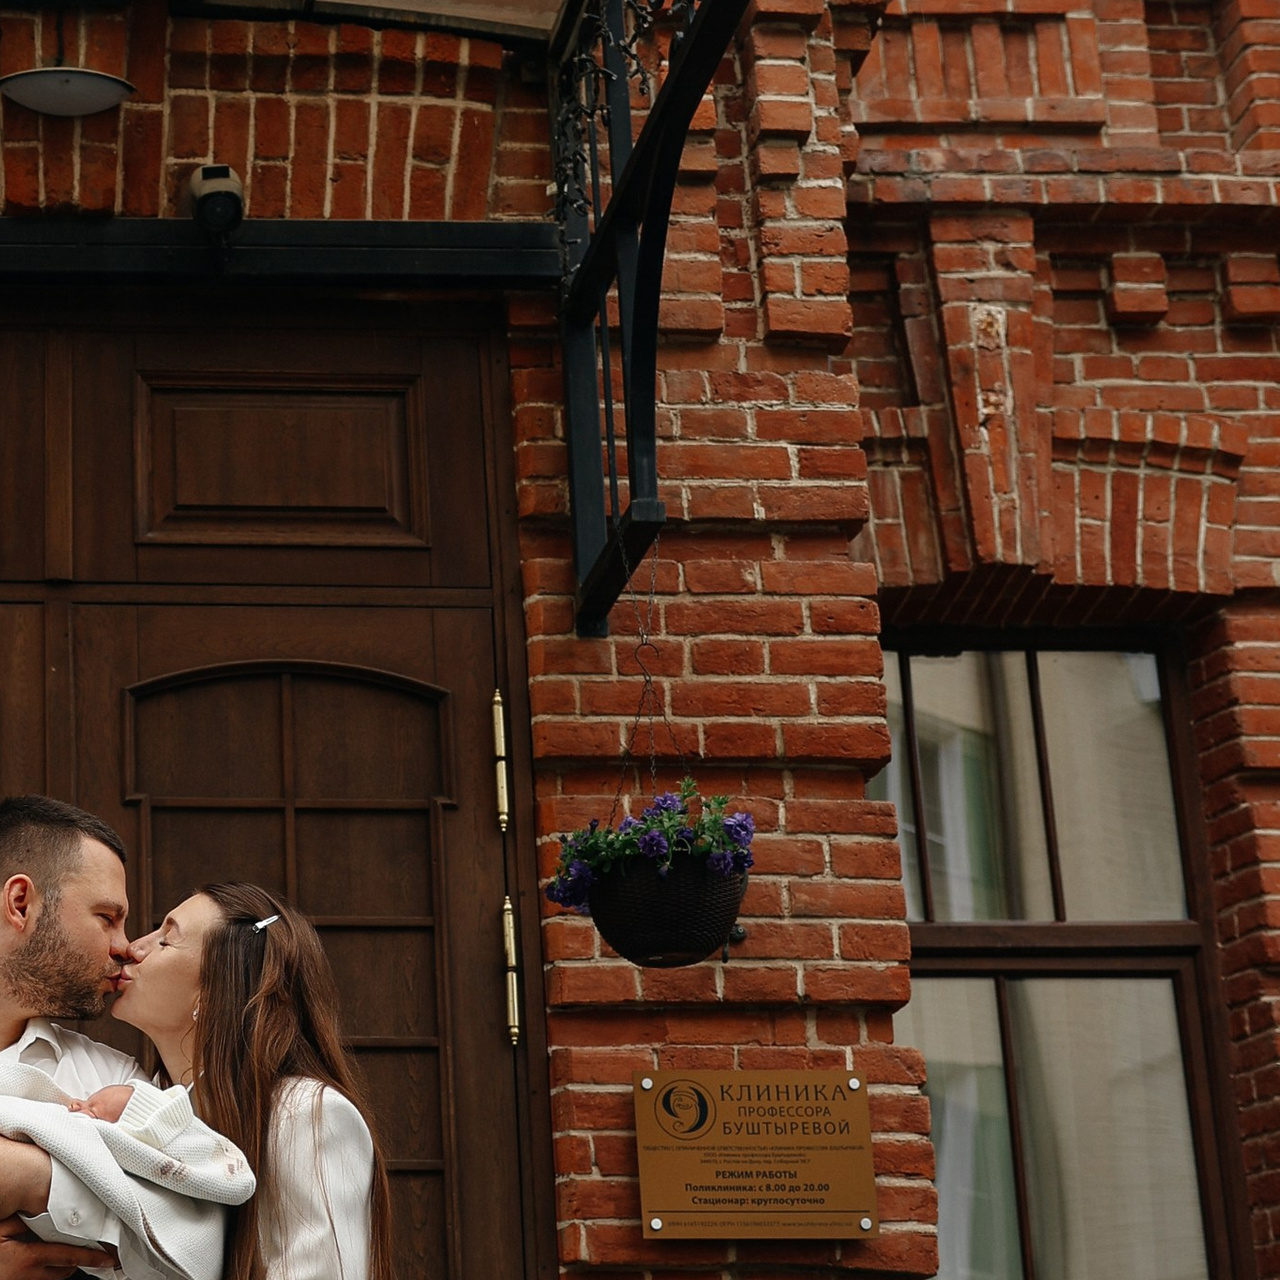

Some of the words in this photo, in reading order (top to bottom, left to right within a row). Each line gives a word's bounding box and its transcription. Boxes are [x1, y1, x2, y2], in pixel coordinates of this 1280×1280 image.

[720, 1084, 848, 1102] КЛИНИКА
[737, 1106, 832, 1118] ПРОФЕССОРА
[722, 1119, 851, 1136] БУШТЫРЕВОЙ
[715, 1170, 754, 1180] РЕЖИМ
[755, 1170, 798, 1180] РАБОТЫ
[684, 1183, 757, 1193] Поликлиника:
[765, 1183, 787, 1192] 8.00
[787, 1184, 801, 1194] до
[803, 1183, 830, 1192] 20.00
[691, 1196, 750, 1207] Стационар:
[750, 1197, 826, 1207] круглосуточно
